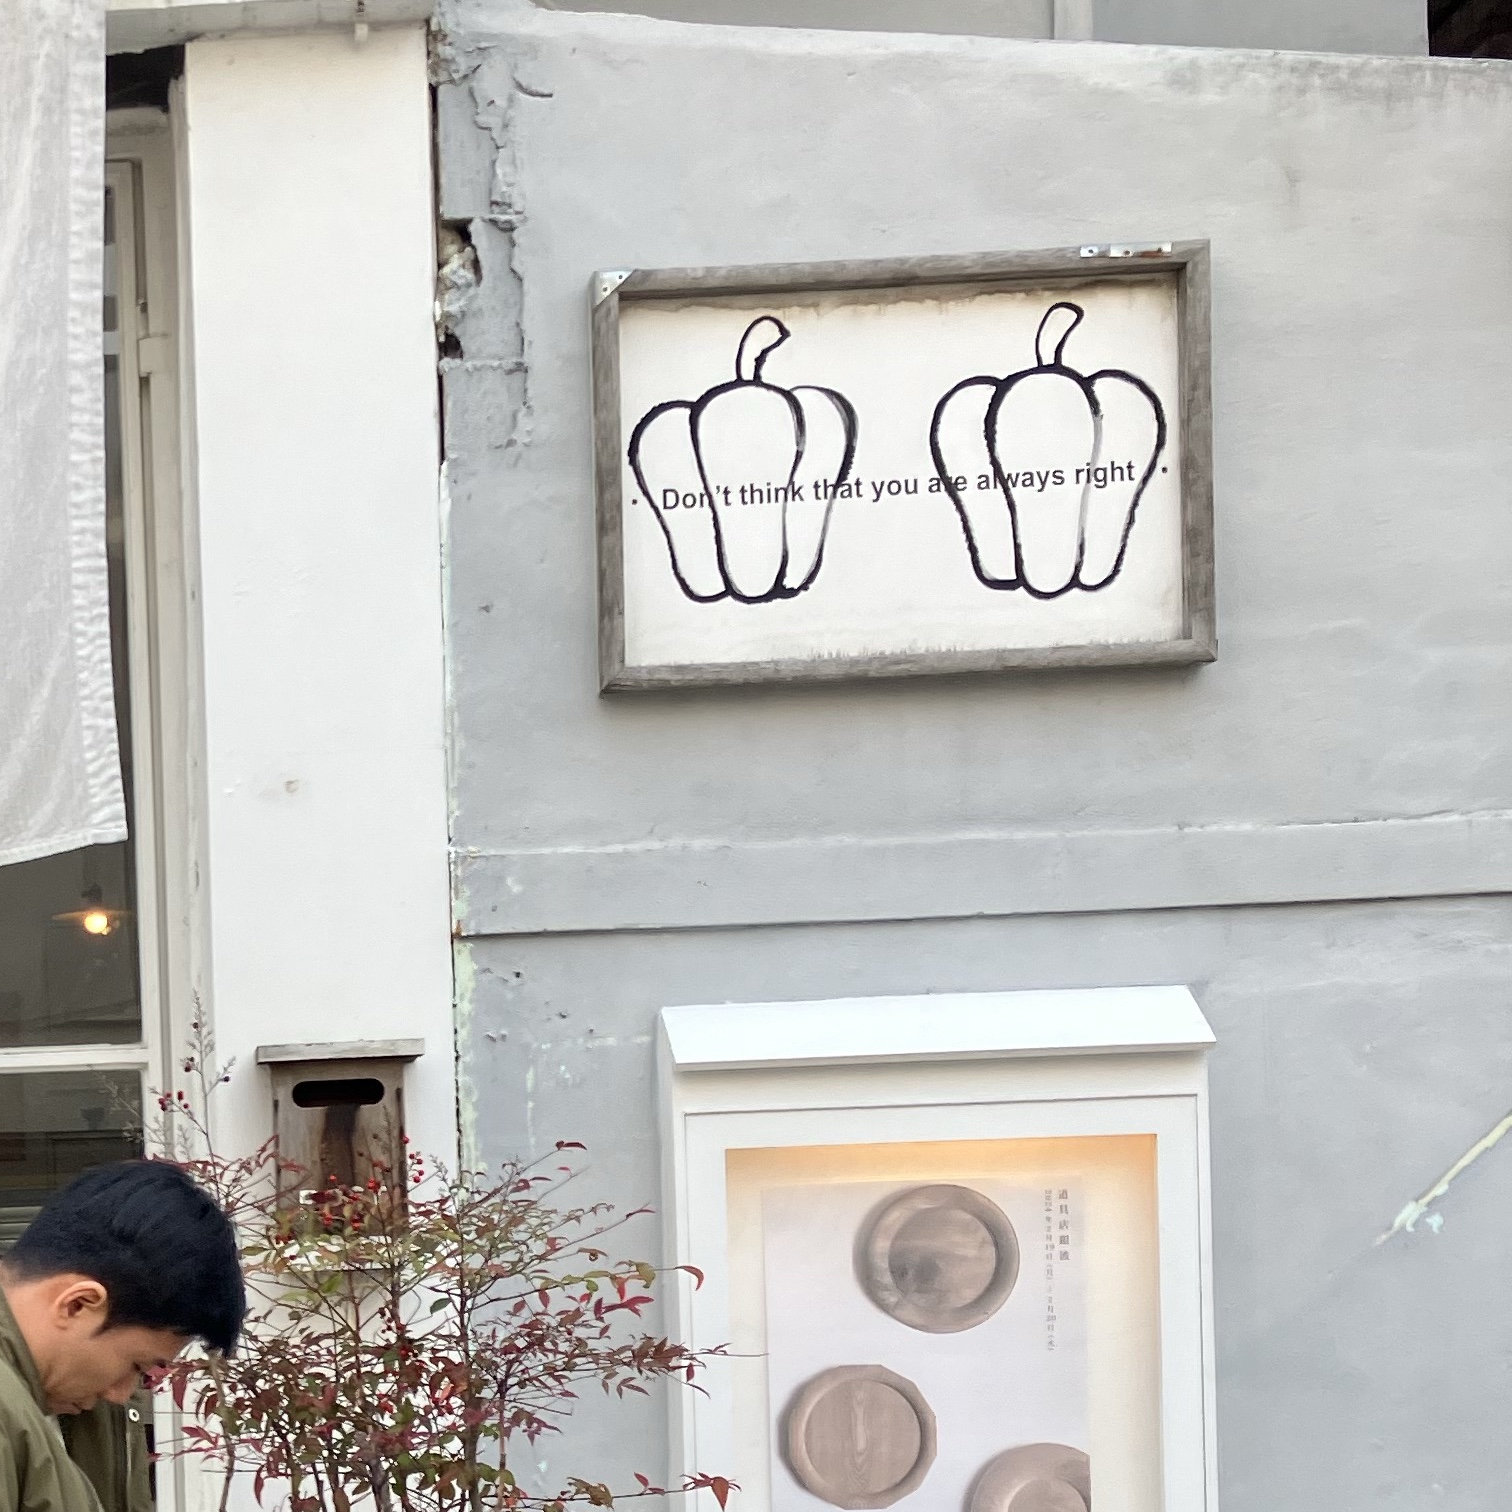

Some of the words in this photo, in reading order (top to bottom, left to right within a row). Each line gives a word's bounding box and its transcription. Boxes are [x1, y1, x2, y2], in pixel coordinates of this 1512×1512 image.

[739, 480, 805, 505] think
[813, 477, 863, 500] that
[872, 478, 918, 502] you
[976, 469, 1065, 493] always
[1075, 461, 1136, 489] right
